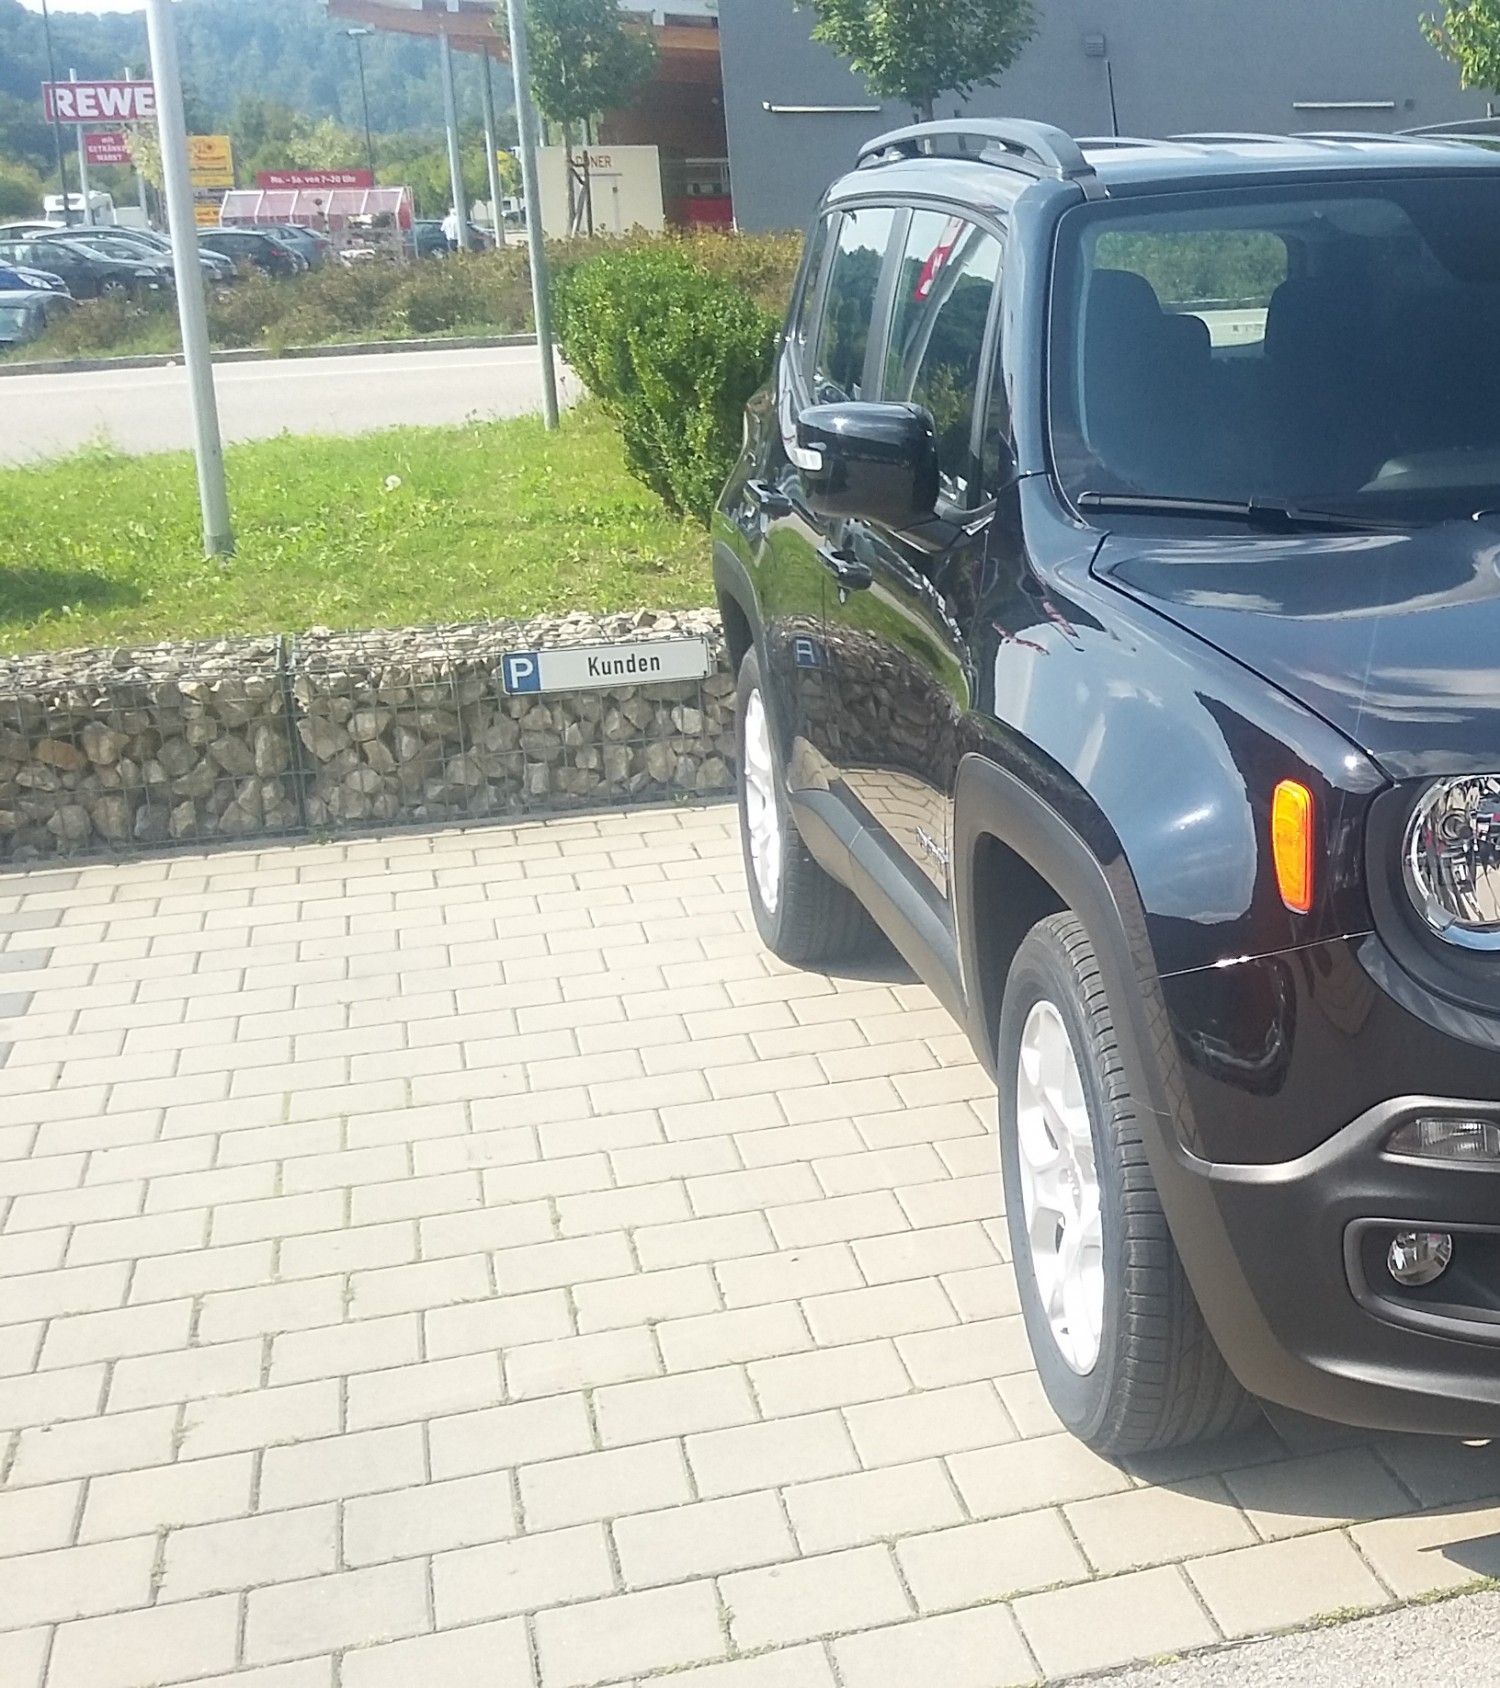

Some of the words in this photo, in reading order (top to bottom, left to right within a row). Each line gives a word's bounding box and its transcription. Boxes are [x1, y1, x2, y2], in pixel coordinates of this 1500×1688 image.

[49, 87, 157, 117] REWE
[575, 155, 612, 168] DNER
[509, 658, 533, 689] P
[588, 653, 661, 677] Kunden
